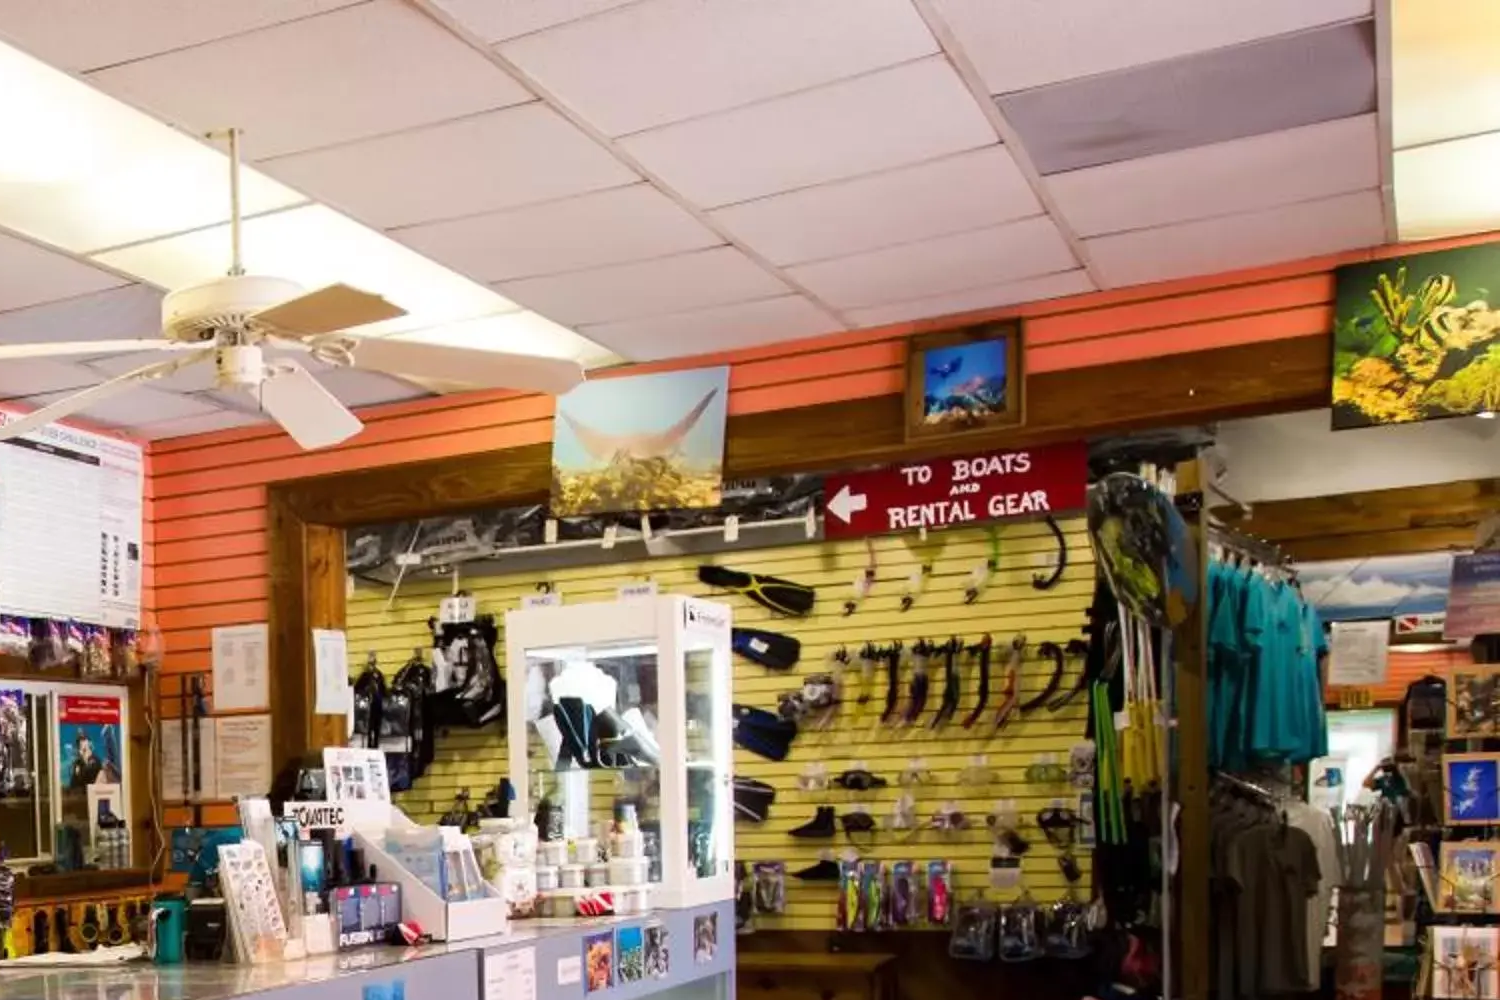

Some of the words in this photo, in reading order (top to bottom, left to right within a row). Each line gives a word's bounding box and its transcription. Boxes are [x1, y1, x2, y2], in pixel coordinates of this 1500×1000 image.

[901, 465, 932, 485] TO
[951, 453, 1030, 481] BOATS
[950, 482, 980, 495] AND
[887, 502, 975, 529] RENTAL
[988, 490, 1049, 517] GEAR
